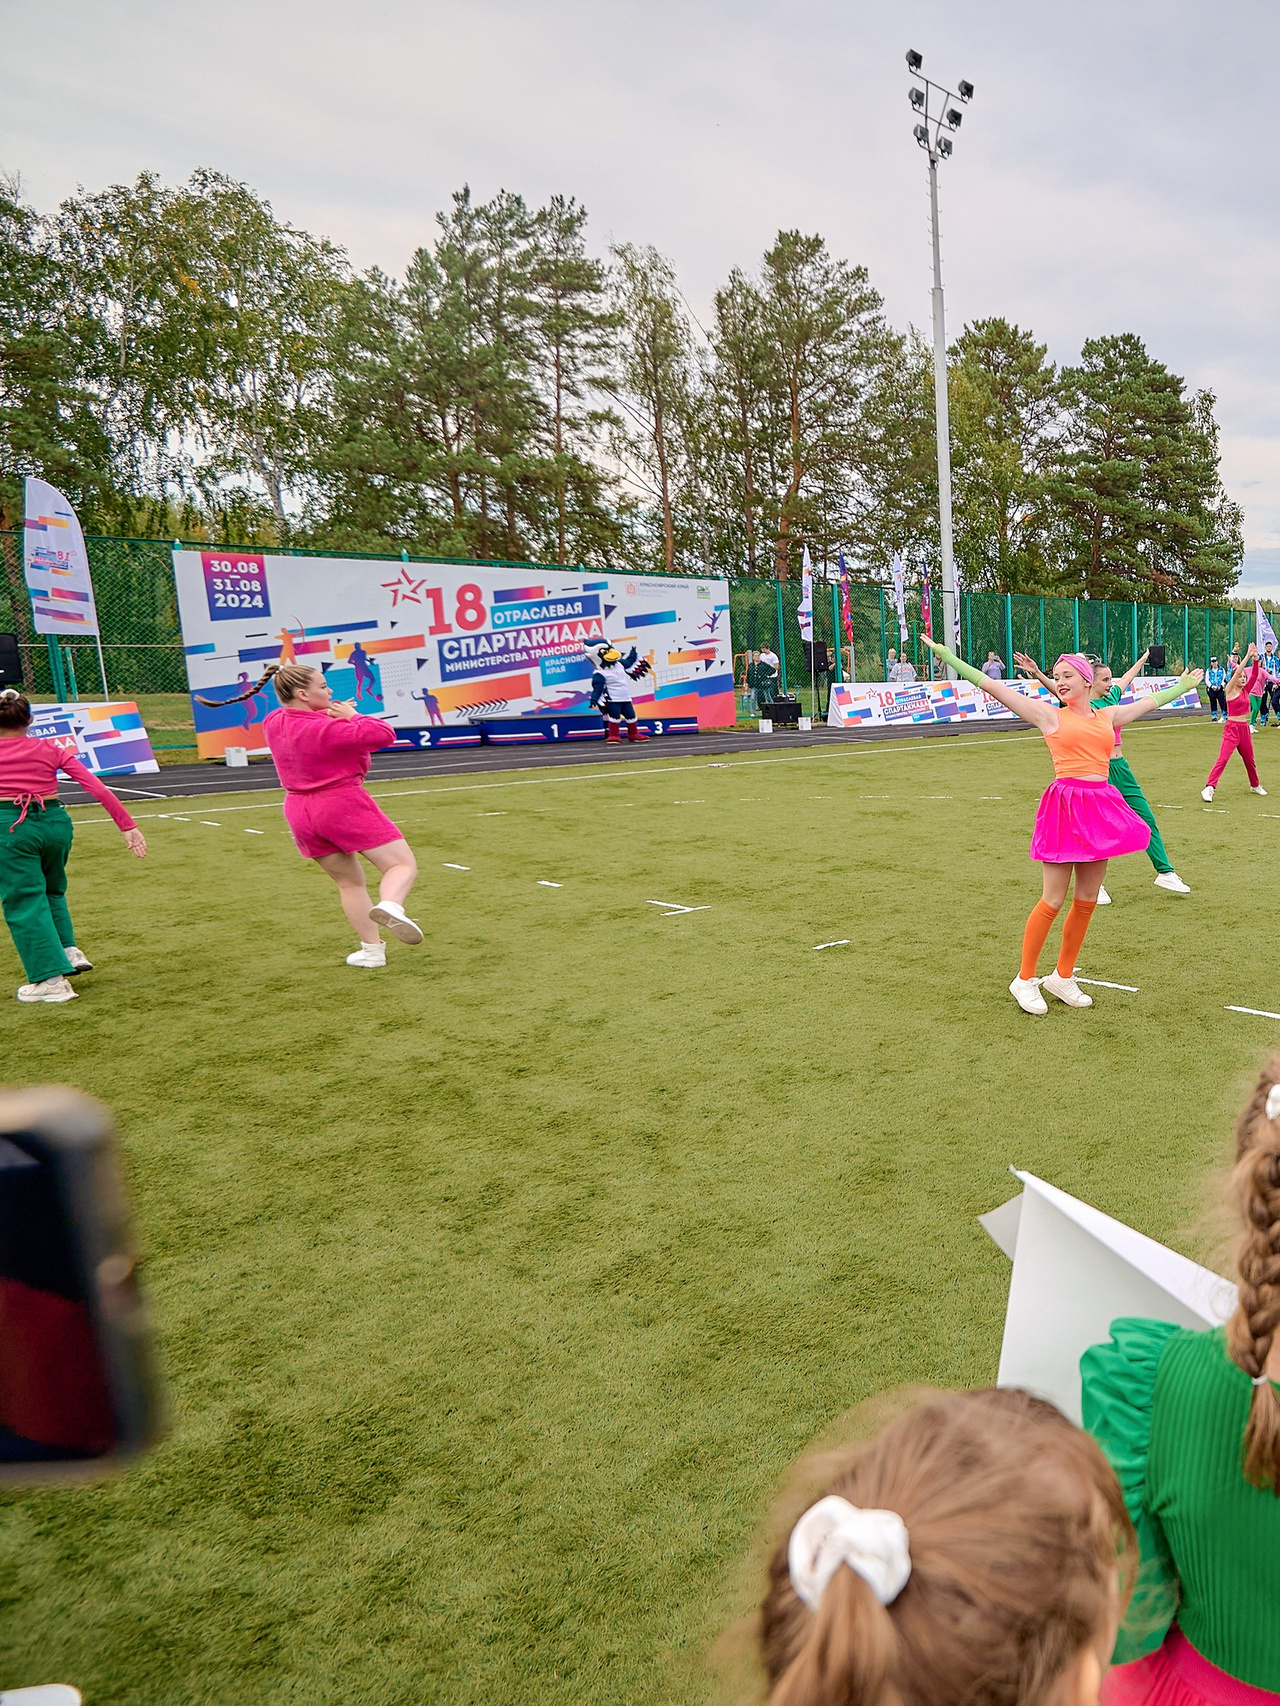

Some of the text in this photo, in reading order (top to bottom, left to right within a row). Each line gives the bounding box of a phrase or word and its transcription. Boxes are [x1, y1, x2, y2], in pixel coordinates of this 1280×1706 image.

[210, 560, 259, 574] 30.08
[213, 578, 262, 592] 31.08
[214, 593, 264, 608] 2024
[426, 583, 583, 636] 18 ОТРАСЛЕВАЯ
[442, 620, 602, 660] СПАРТАКИАДА
[445, 642, 585, 673] МИНИСТЕРСТВА ТРАНСПОРТ
[545, 655, 586, 667] КРАСНОЯР
[546, 665, 566, 675] КРАЯ
[877, 690, 895, 707] 18
[550, 724, 559, 738] 1
[654, 721, 663, 735] 3
[419, 731, 431, 746] 2
